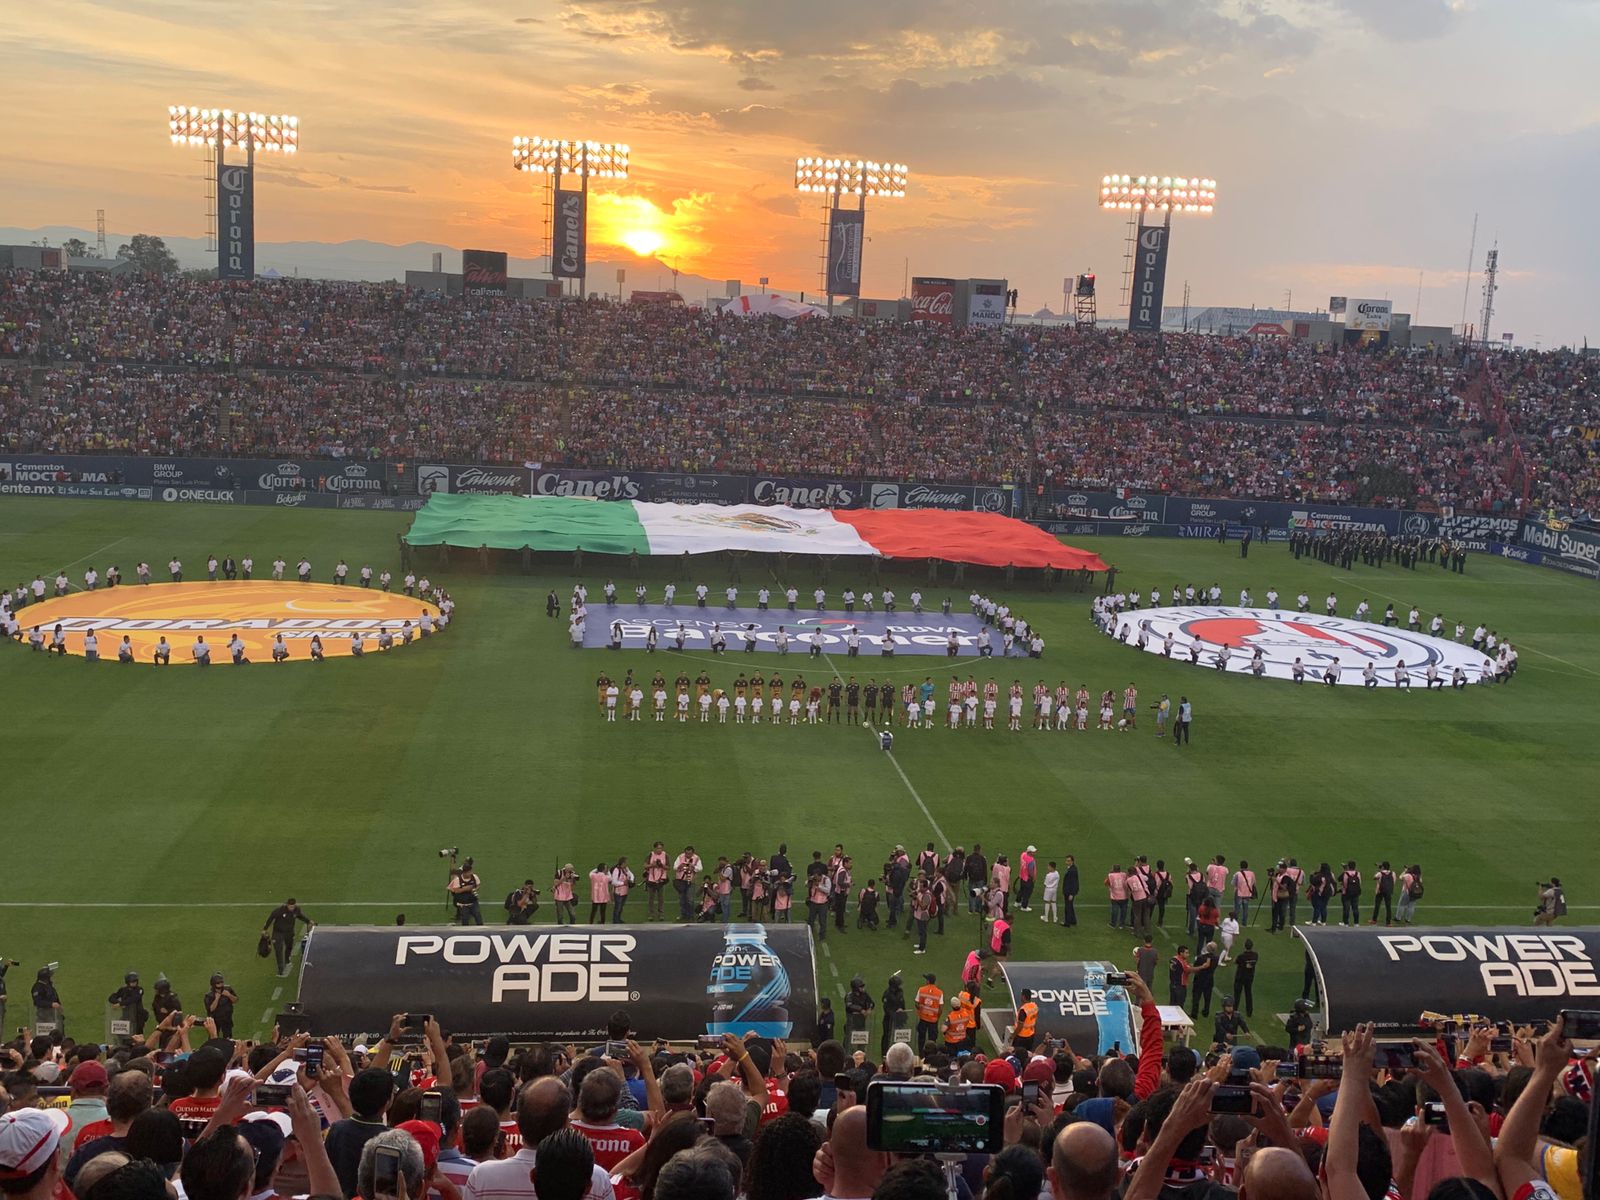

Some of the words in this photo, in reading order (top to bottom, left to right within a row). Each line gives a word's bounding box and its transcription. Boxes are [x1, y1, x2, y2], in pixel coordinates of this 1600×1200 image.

[221, 168, 248, 270] Corona
[561, 195, 580, 273] Canel's
[1139, 228, 1165, 322] Corona
[972, 311, 1002, 320] MANDO
[15, 462, 65, 471] Cementos
[153, 463, 176, 471] BMW
[153, 470, 183, 478] GROUP
[326, 475, 381, 491] Corona
[456, 468, 522, 487] Caliente
[537, 473, 641, 498] Canel's
[0, 483, 55, 495] ente.mx
[179, 489, 234, 501] ONECLICK
[754, 480, 854, 506] Canel's
[905, 486, 967, 505] Caliente
[1191, 503, 1211, 511] BMW
[1310, 511, 1351, 521] Cementos
[1523, 524, 1558, 550] Mobil
[1560, 535, 1600, 561] Super
[609, 618, 763, 630] ASCENSO
[612, 623, 979, 646] Bancomer
[395, 934, 637, 965] POWER
[1377, 935, 1592, 962] POWER
[712, 953, 783, 968] POWER
[710, 965, 752, 982] ADE
[1480, 961, 1600, 997] ADE
[491, 964, 630, 1003] ADE
[1060, 1002, 1110, 1016] ADE
